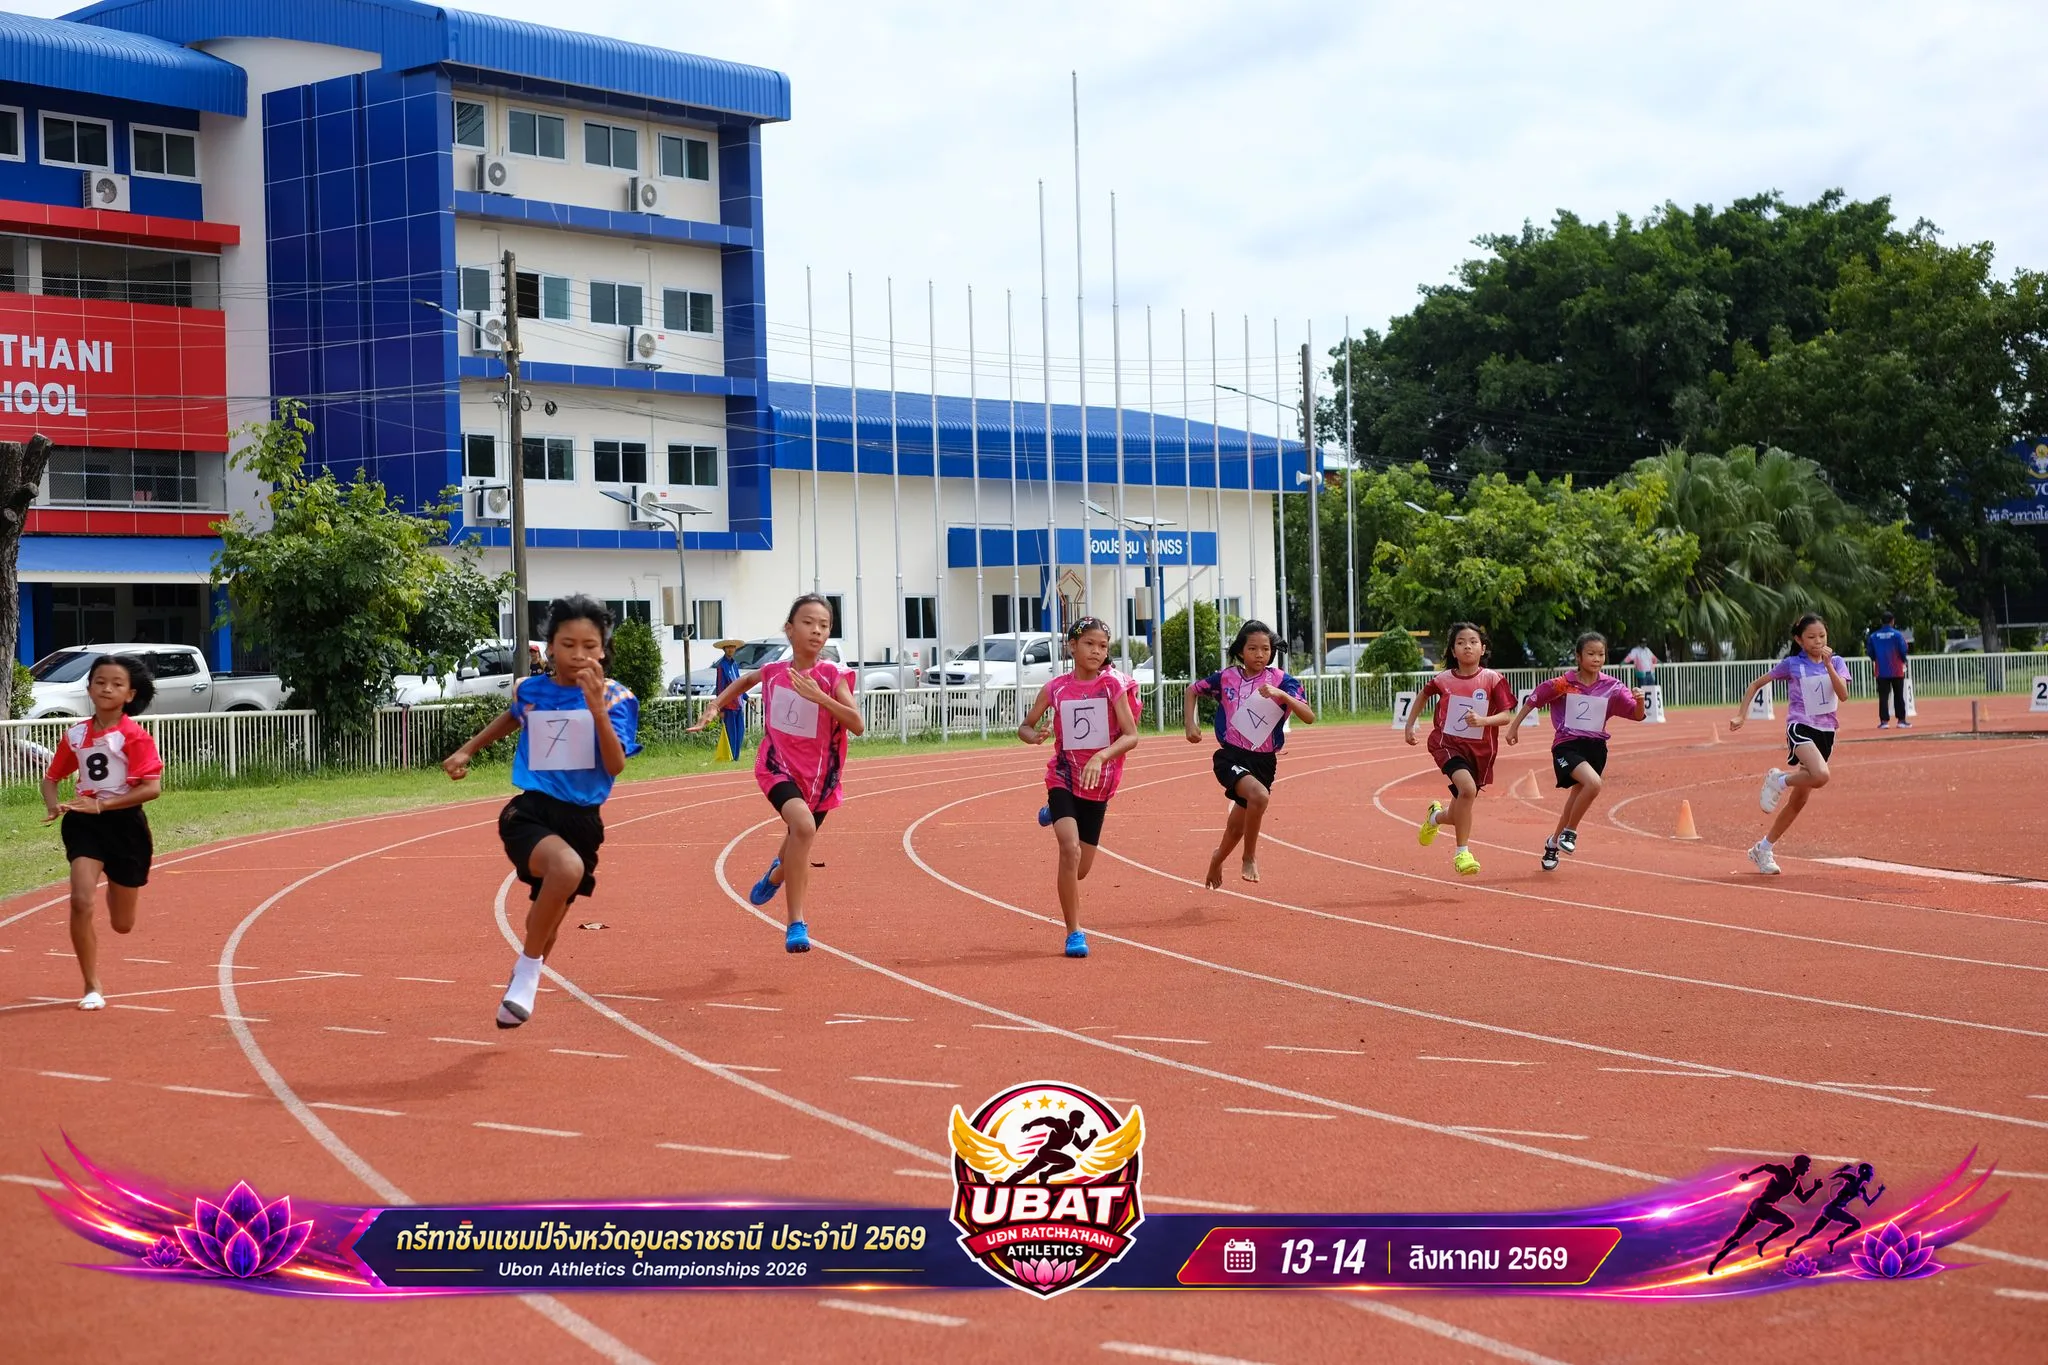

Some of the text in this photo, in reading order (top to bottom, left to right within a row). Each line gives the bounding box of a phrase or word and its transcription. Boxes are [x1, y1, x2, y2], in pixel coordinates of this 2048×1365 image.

[0, 334, 113, 373] THANI
[1644, 691, 1652, 709] 5
[1754, 689, 1764, 707] 4
[1814, 681, 1829, 705] 1
[2036, 682, 2048, 699] 2
[786, 698, 799, 725] 6
[1399, 697, 1412, 716] 7
[1575, 701, 1592, 721] 2
[1073, 706, 1095, 740] 5
[1246, 708, 1269, 729] 4
[544, 718, 570, 759] 7
[86, 752, 109, 781] 8
